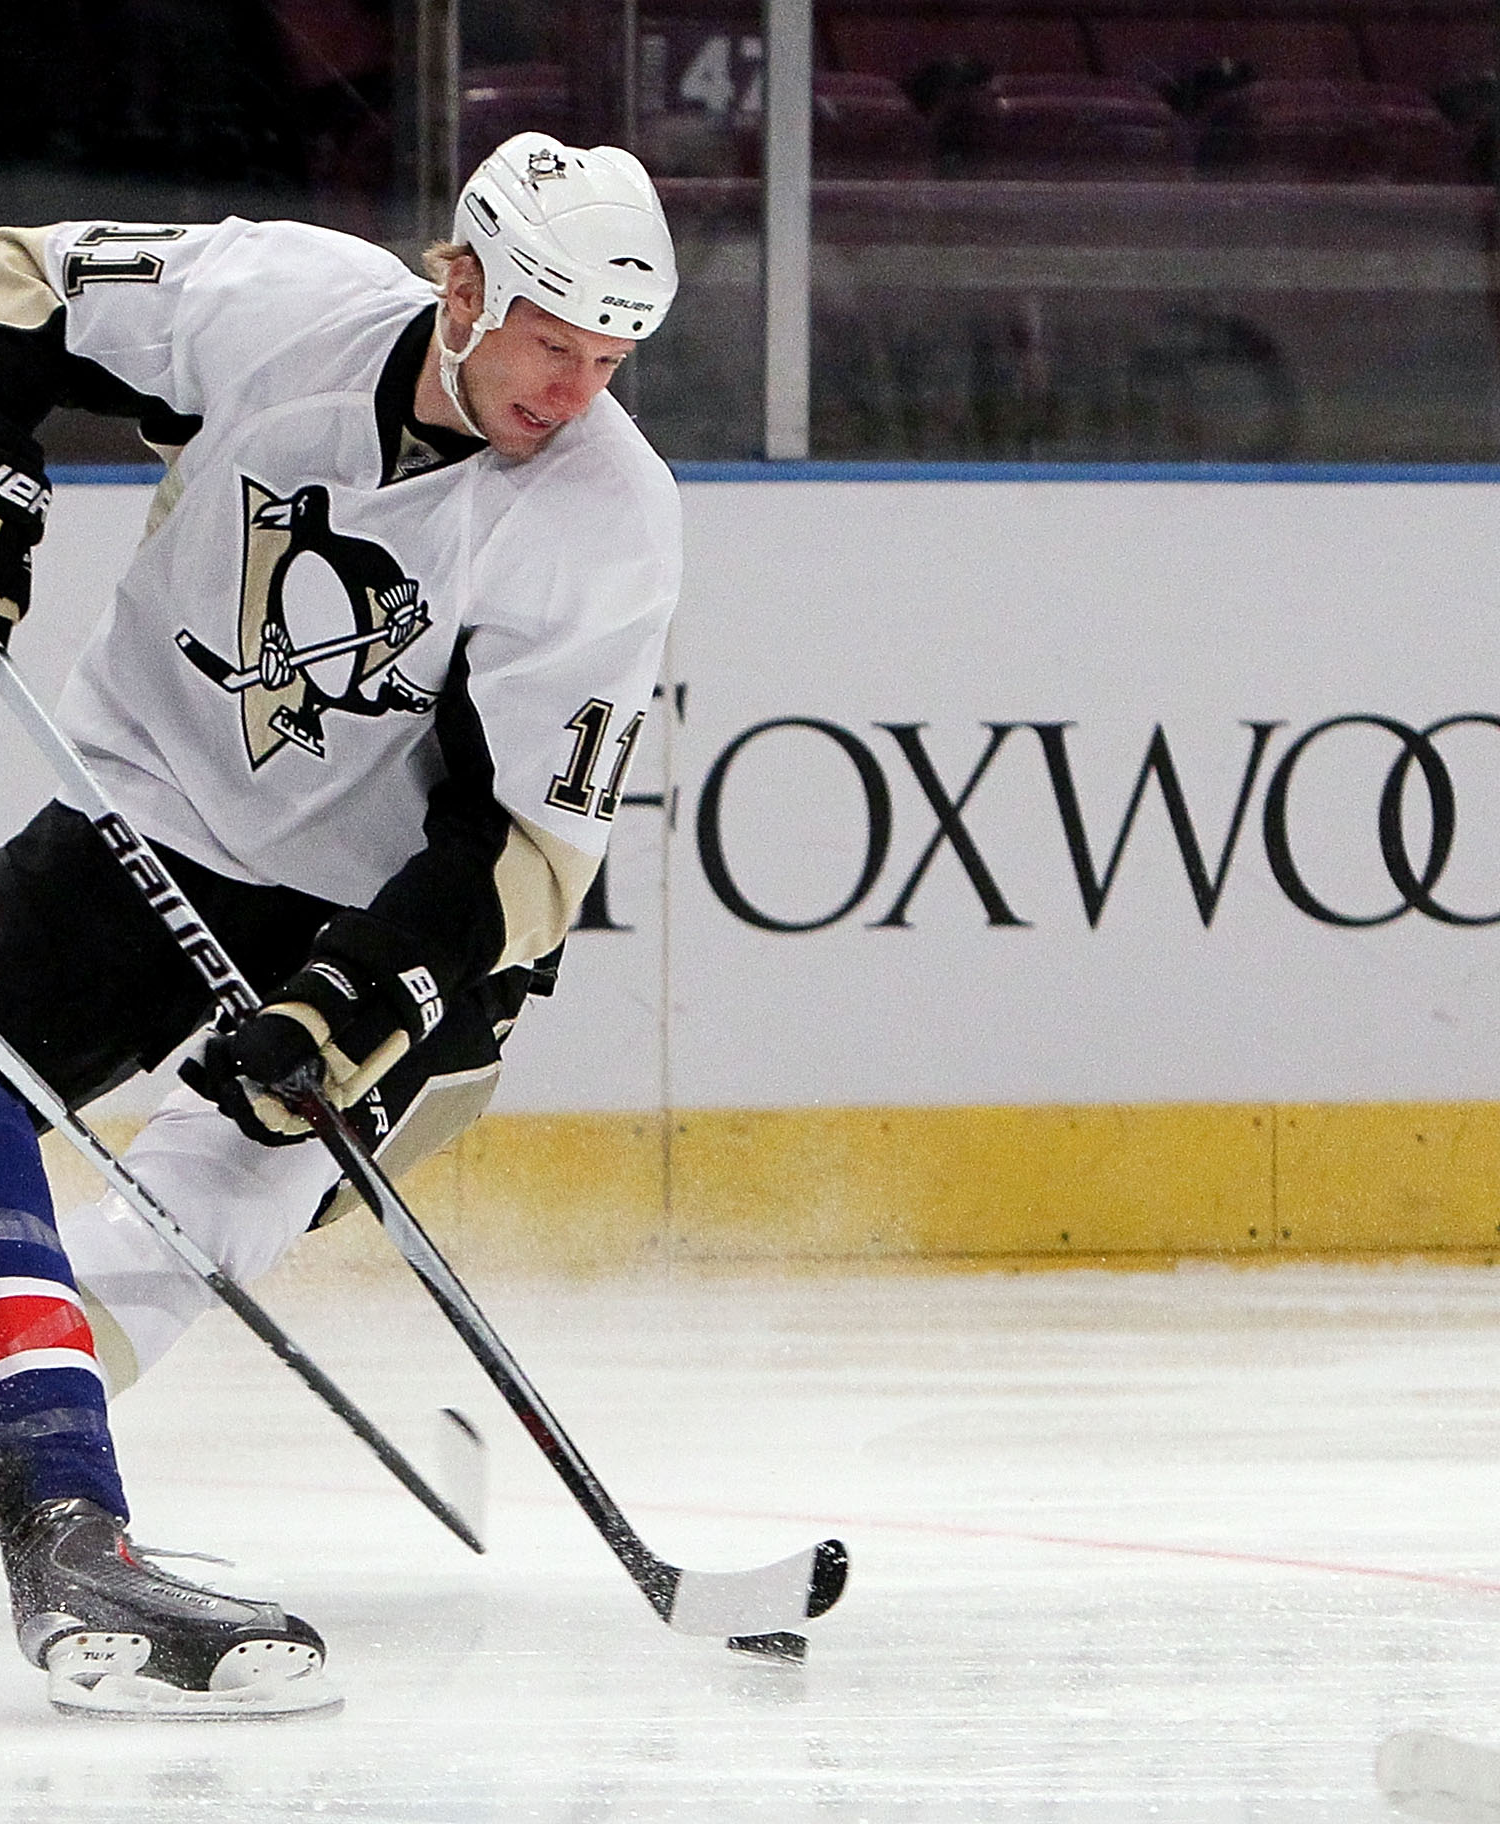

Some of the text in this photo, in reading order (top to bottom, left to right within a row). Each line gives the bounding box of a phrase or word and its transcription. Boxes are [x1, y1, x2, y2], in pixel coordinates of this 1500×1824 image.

[64, 225, 190, 298] 11
[544, 696, 646, 823] 11
[83, 1651, 117, 1661] TUK
